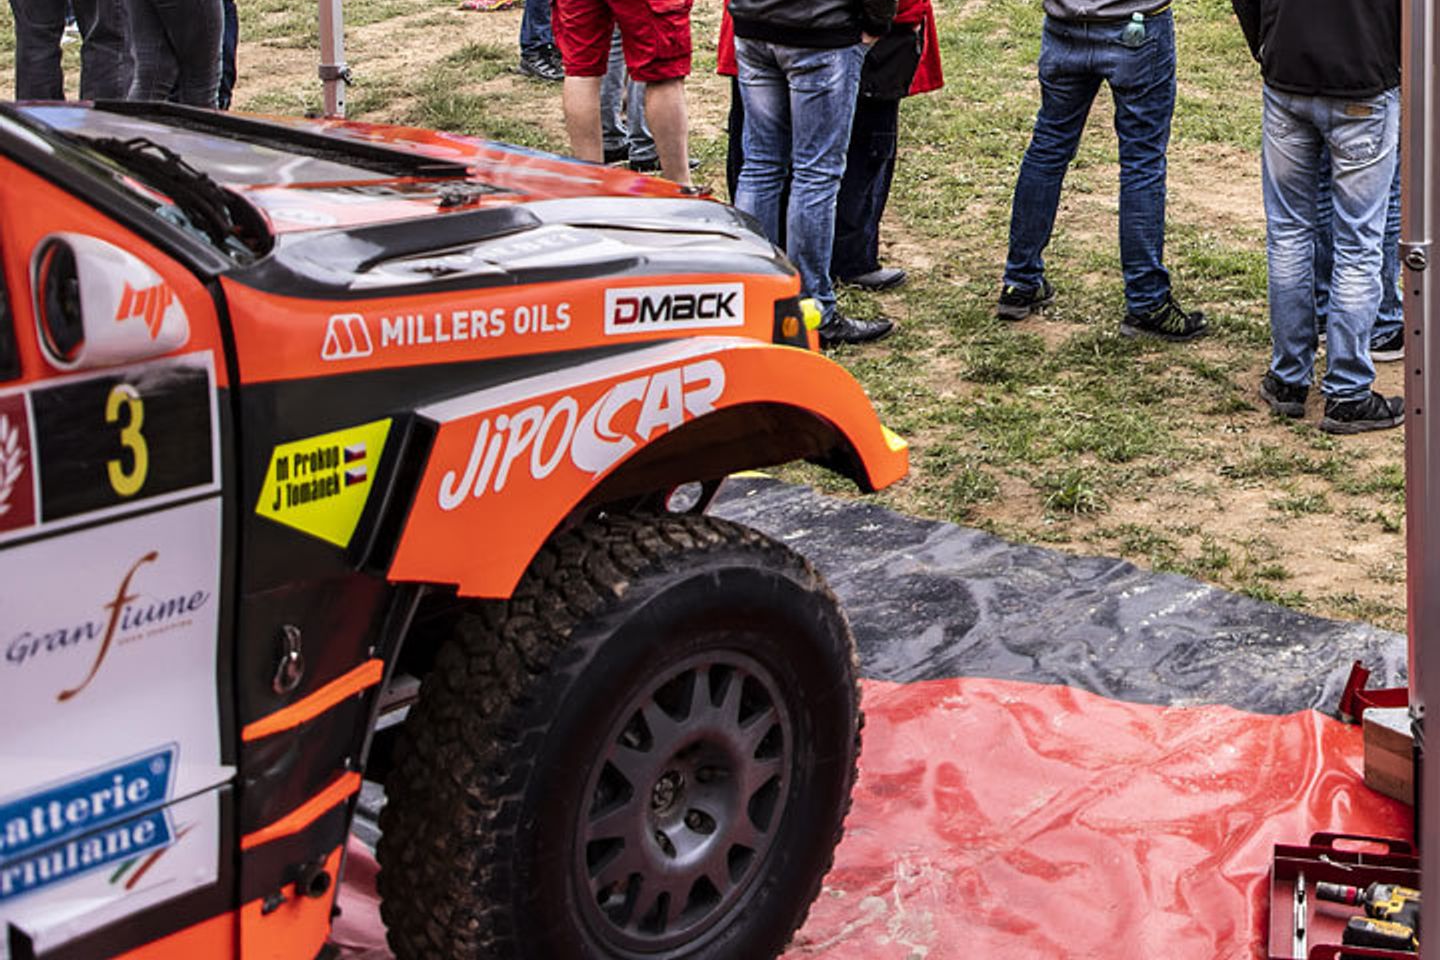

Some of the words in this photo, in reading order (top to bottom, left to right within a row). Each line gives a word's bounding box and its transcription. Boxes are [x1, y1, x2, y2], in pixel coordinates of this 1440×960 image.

[381, 308, 506, 347] MILLERS
[514, 303, 571, 335] OILS
[105, 384, 148, 496] 3
[276, 456, 289, 481] M
[294, 445, 340, 478] Prokop
[273, 485, 281, 511] J
[0, 775, 150, 851] atterie
